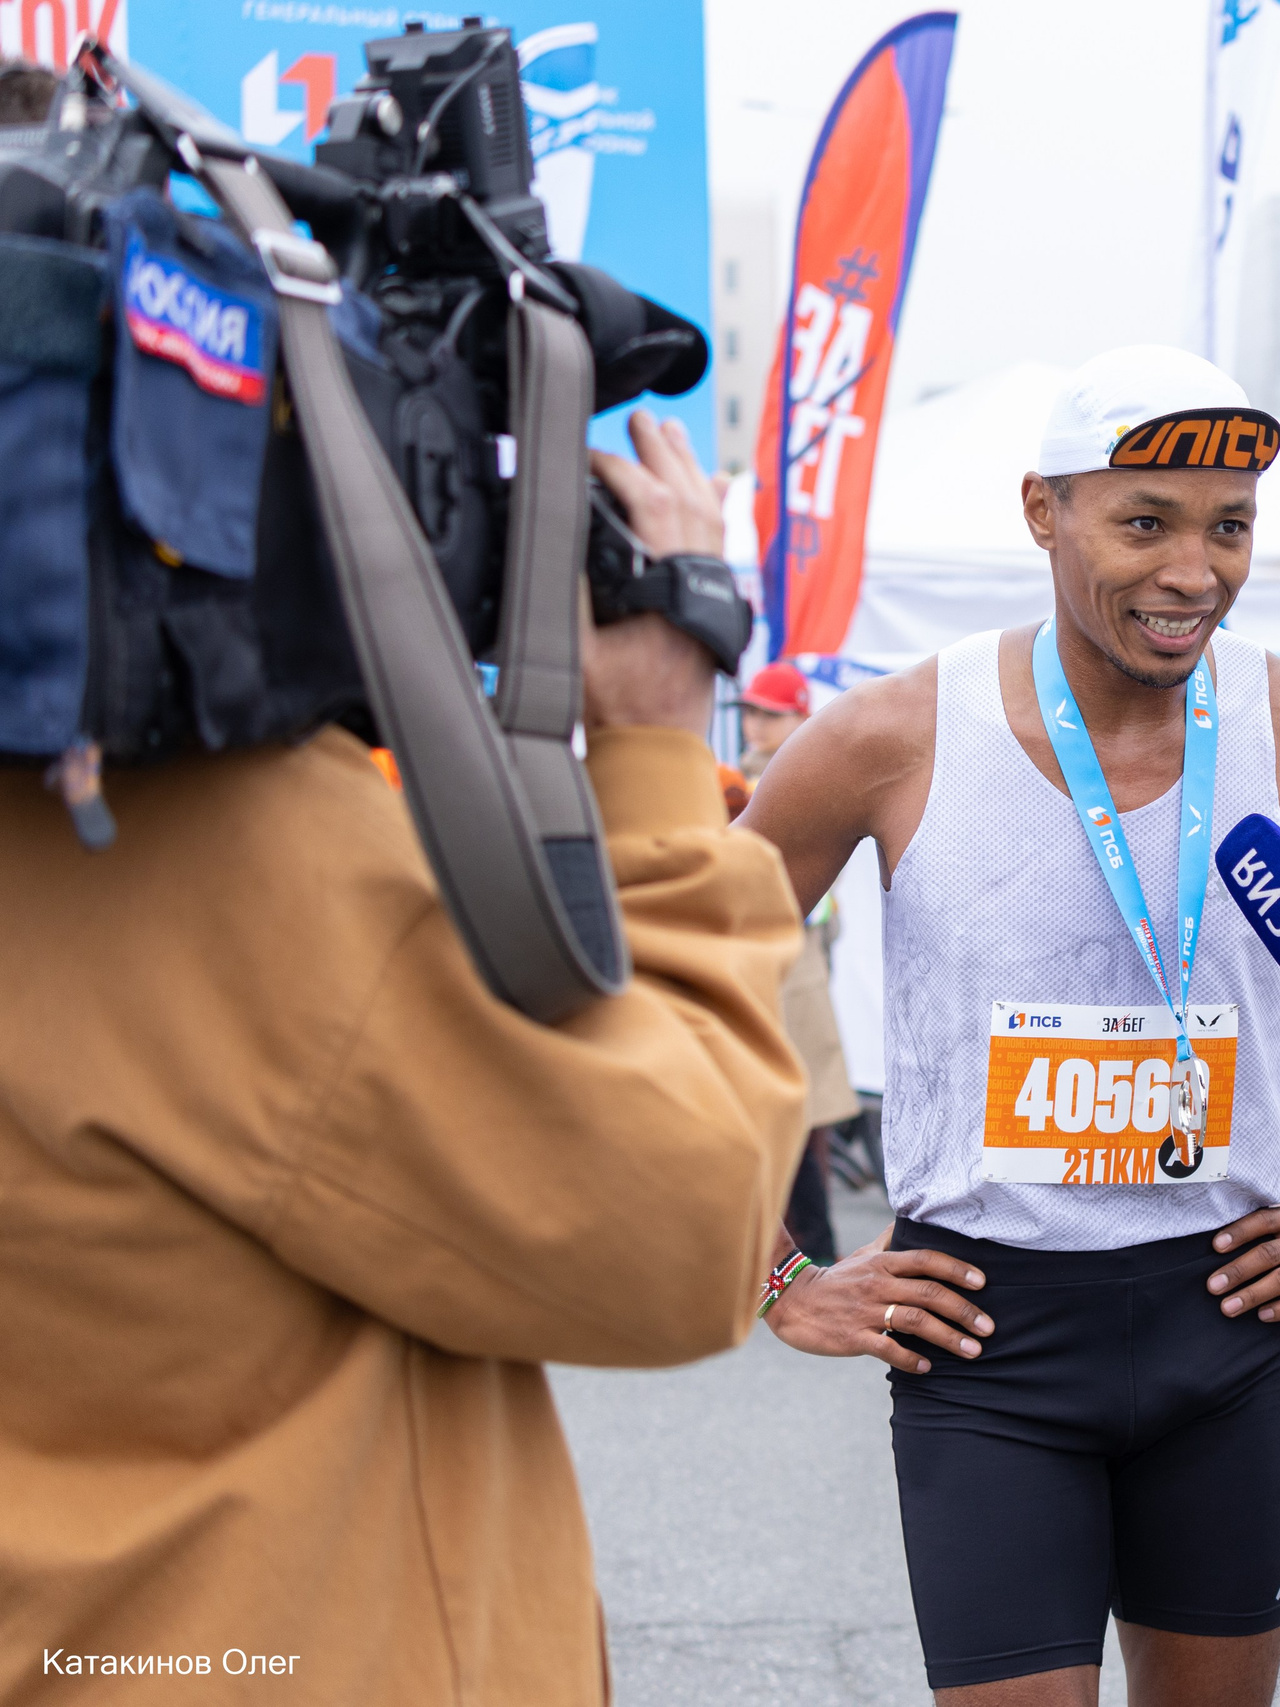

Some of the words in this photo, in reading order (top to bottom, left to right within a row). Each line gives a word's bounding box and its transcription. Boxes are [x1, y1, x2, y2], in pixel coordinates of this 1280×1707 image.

[786, 403, 866, 519] ЕГ
[1194, 669, 1209, 706] ПСБ
[1099, 829, 1124, 870] ПСБ
[1183, 916, 1194, 956] ПСБ
[1029, 1015, 1063, 1029] ПСБ
[1014, 1057, 1210, 1134] 4056
